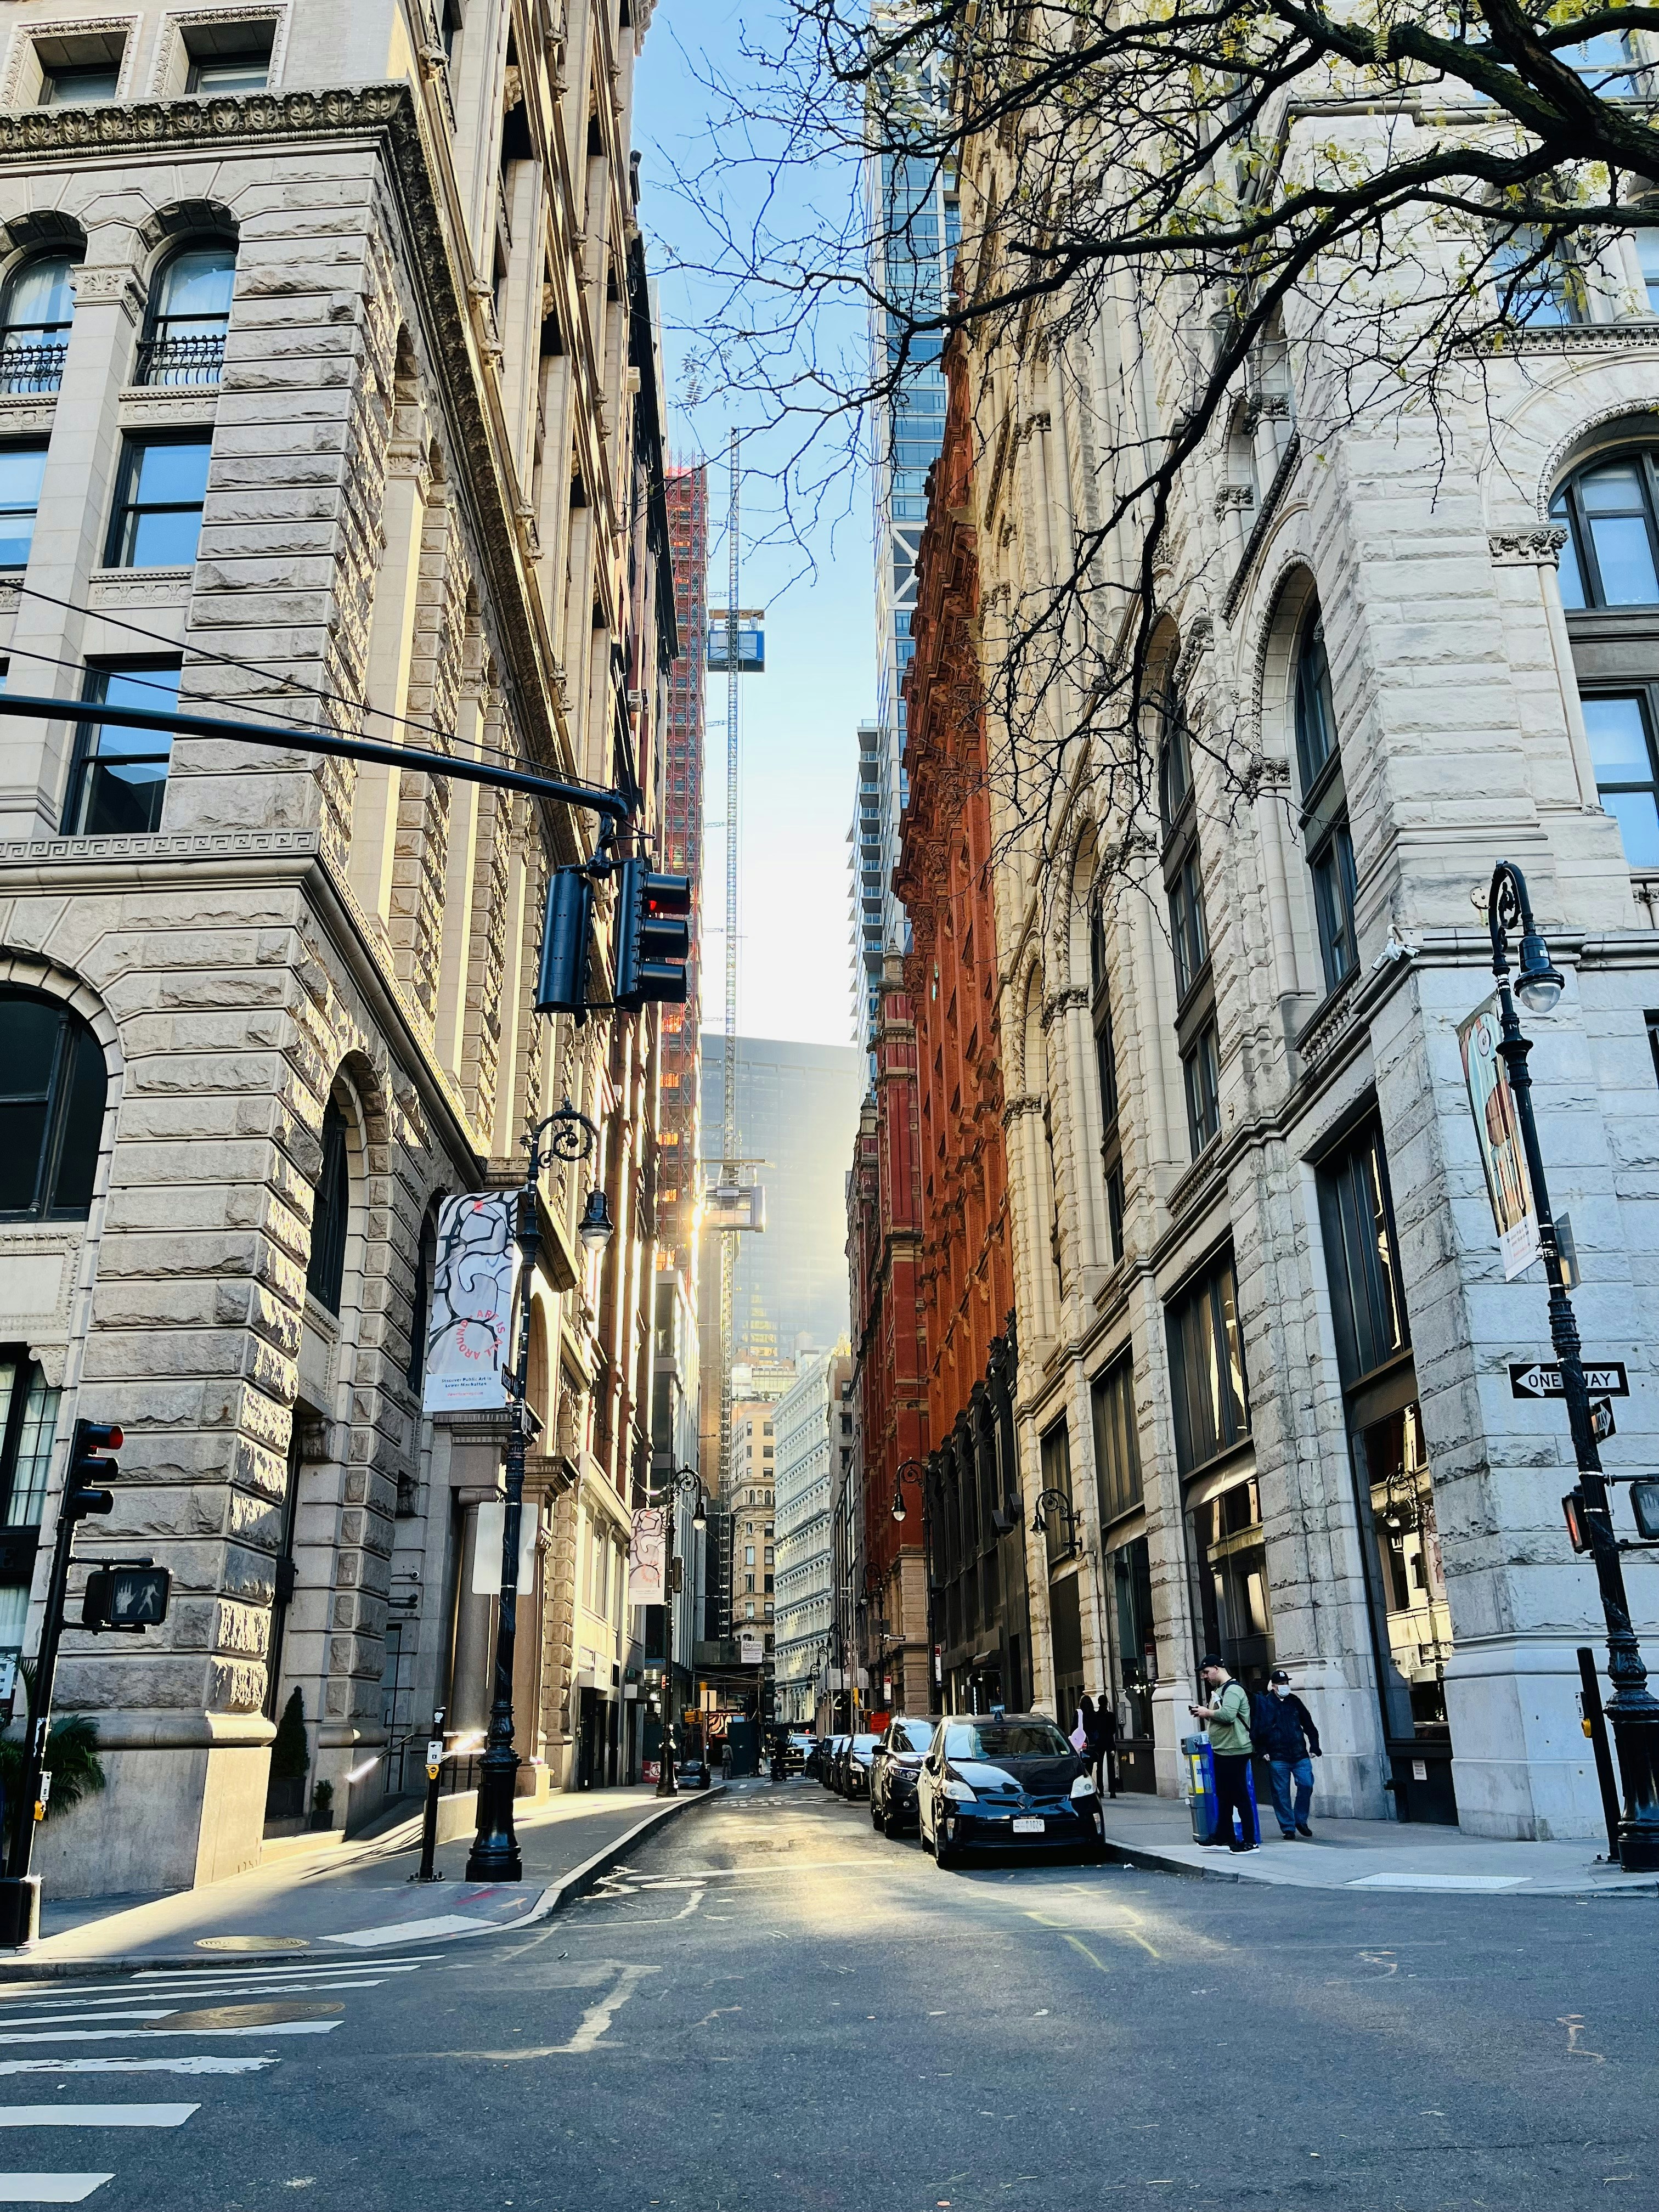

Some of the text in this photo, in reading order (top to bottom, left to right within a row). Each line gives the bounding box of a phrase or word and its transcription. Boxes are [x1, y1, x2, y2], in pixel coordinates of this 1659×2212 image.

[456, 1310, 505, 1360] ART IS ALL AROUND
[1528, 1374, 1561, 1387] ONE
